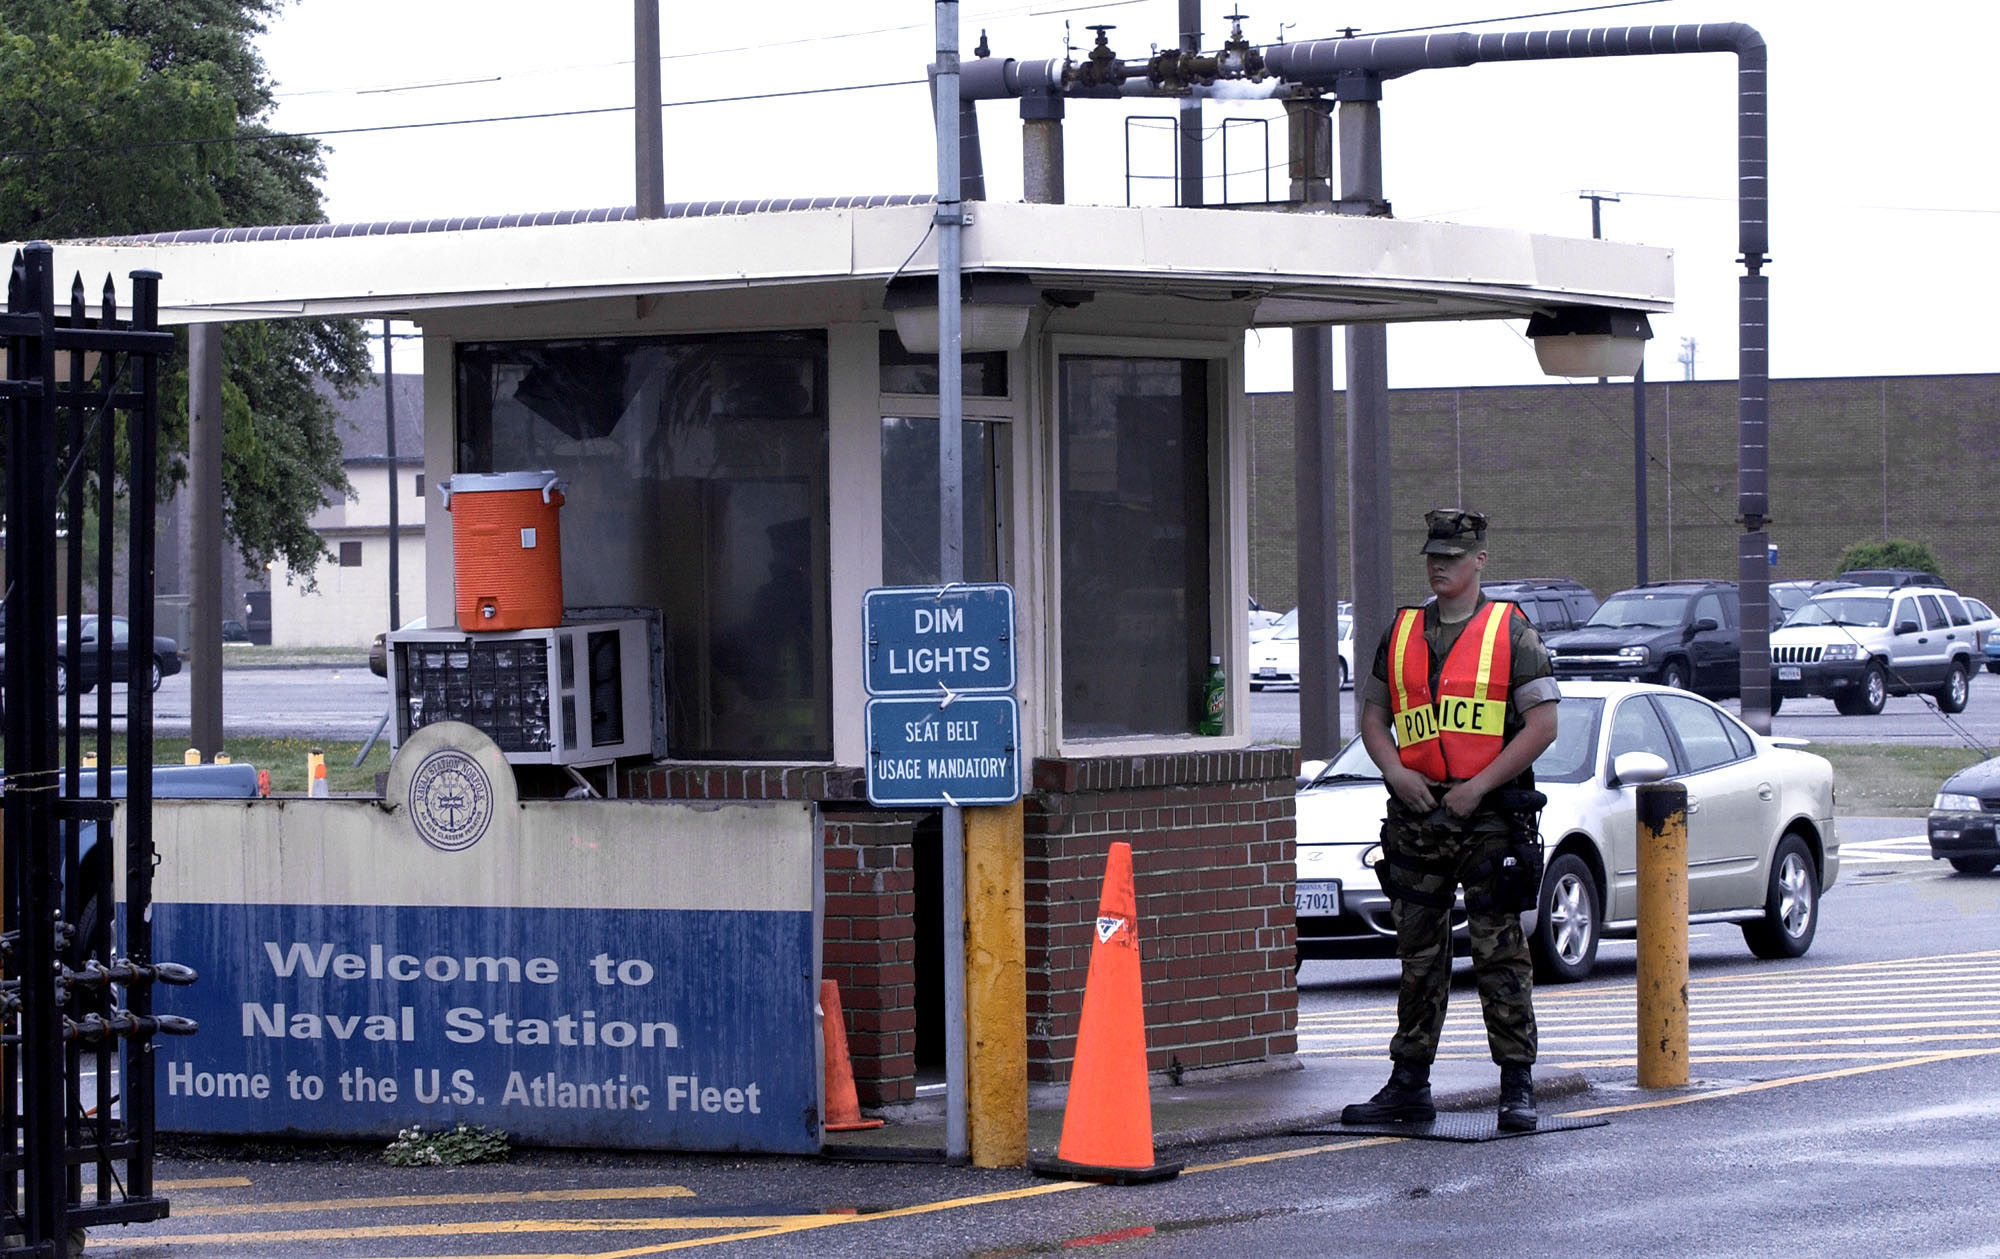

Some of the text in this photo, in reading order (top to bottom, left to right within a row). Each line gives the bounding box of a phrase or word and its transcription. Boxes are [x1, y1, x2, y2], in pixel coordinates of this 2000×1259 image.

[915, 608, 964, 634] DIM
[889, 647, 991, 674] LIGHTS
[905, 721, 979, 743] SEAT BELT
[1404, 700, 1485, 742] POLICE
[416, 758, 486, 801] NAVAL STATION NORFOLK
[879, 757, 1007, 779] USAGE MANDATORY
[263, 942, 654, 986] Welcome to
[242, 1002, 678, 1048] Naval Station
[168, 1062, 762, 1114] Home to the U.S. Atlantic Fleet
